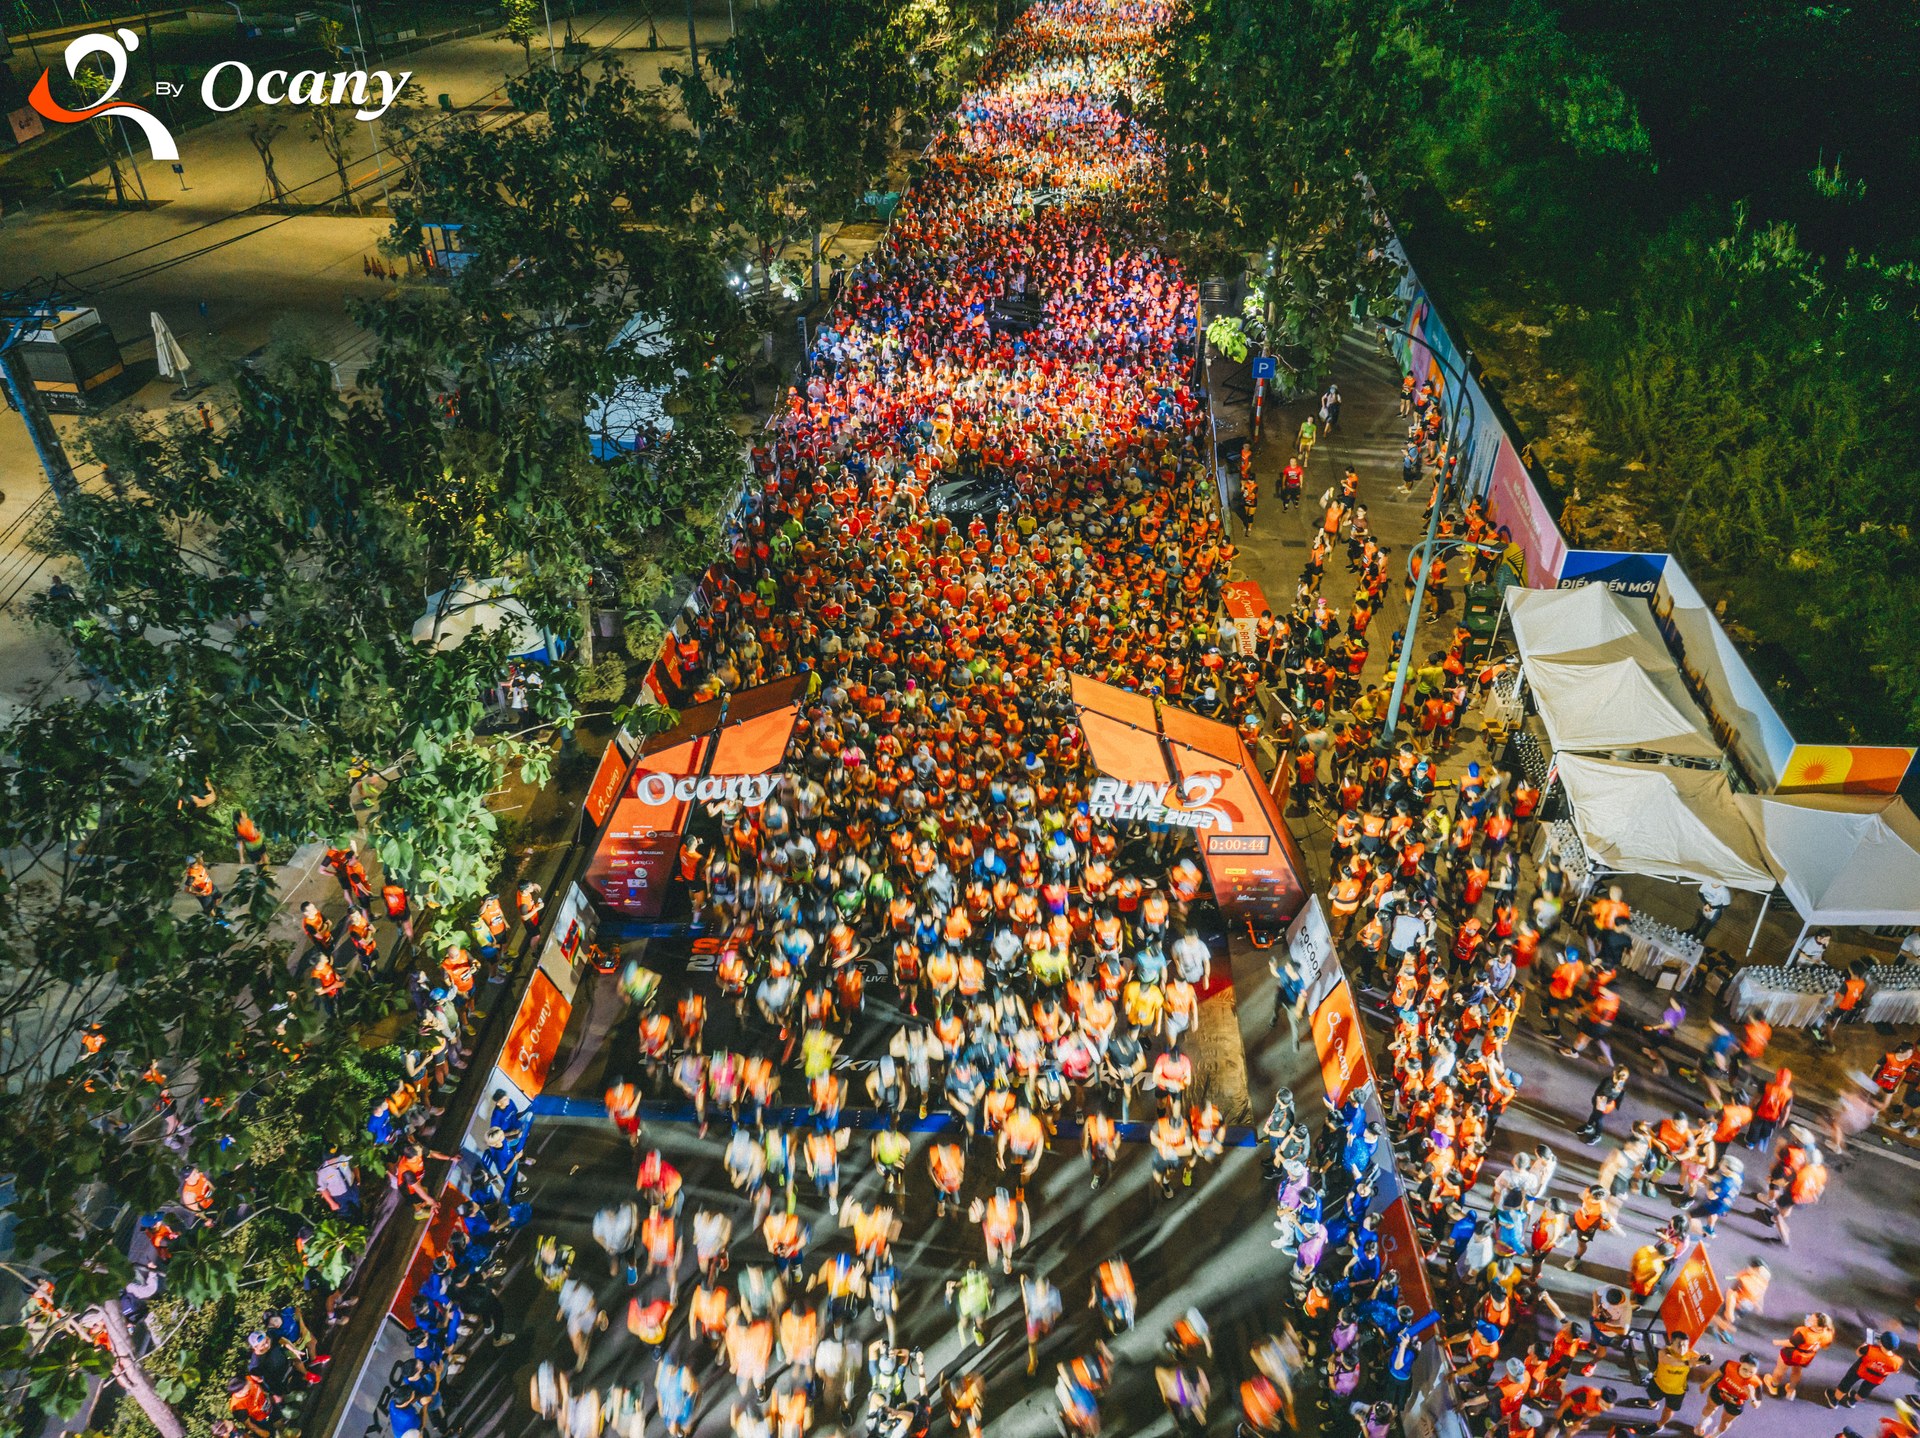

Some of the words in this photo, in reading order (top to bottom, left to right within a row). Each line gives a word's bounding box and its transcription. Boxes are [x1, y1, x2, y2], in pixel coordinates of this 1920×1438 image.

[1258, 362, 1269, 374] P
[1605, 579, 1626, 592] ẾN
[1628, 581, 1656, 593] MỚI
[637, 772, 783, 807] Ocany
[1090, 777, 1170, 806] RUN
[1089, 803, 1115, 818] TO
[1118, 804, 1162, 823] LIVE
[1164, 809, 1215, 829] 2025
[1210, 839, 1265, 851] 0:00:44
[865, 975, 888, 983] LIVE
[530, 999, 553, 1043] Ocany
[1334, 1037, 1350, 1081] Ocany
